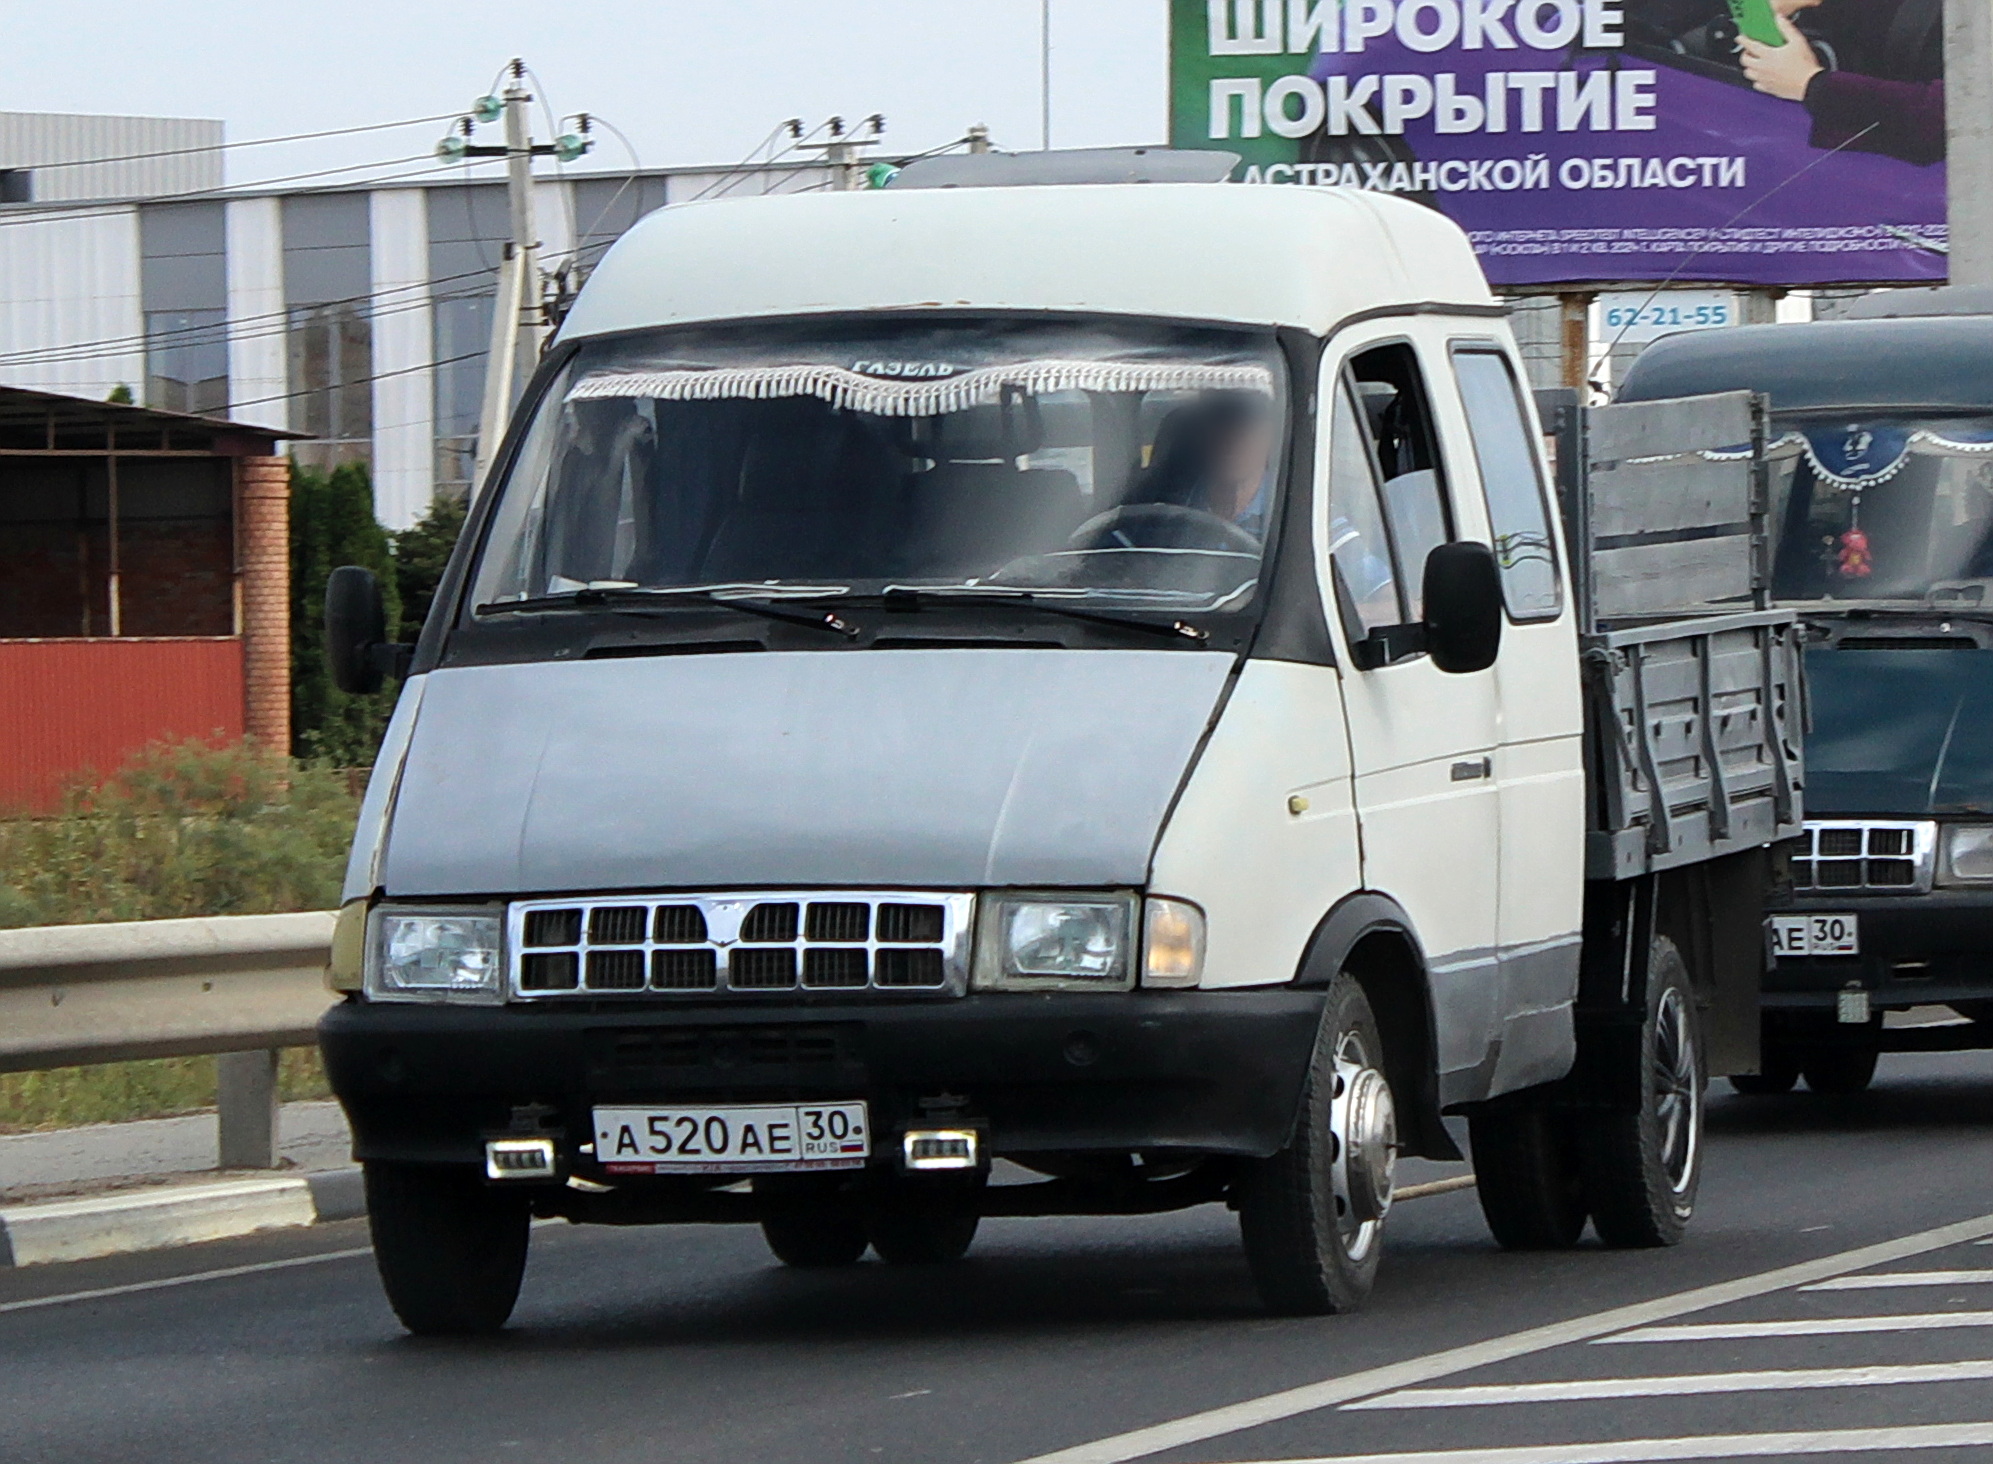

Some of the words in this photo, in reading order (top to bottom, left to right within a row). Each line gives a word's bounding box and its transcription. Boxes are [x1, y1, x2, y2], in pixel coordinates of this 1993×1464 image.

[1208, 0, 1625, 55] ШИРОКОЕ
[1208, 69, 1657, 139] ПОКРЫТИЕ
[1243, 153, 1550, 191] АСТРАХАНСКОЙ
[1558, 156, 1746, 190] ОБЛАСТИ
[1606, 306, 1728, 327] 62-21-55
[852, 361, 954, 377] ГАЗЕЛЬ
[1813, 919, 1845, 941] 30
[804, 1110, 849, 1140] 30
[805, 1142, 838, 1153] RUS
